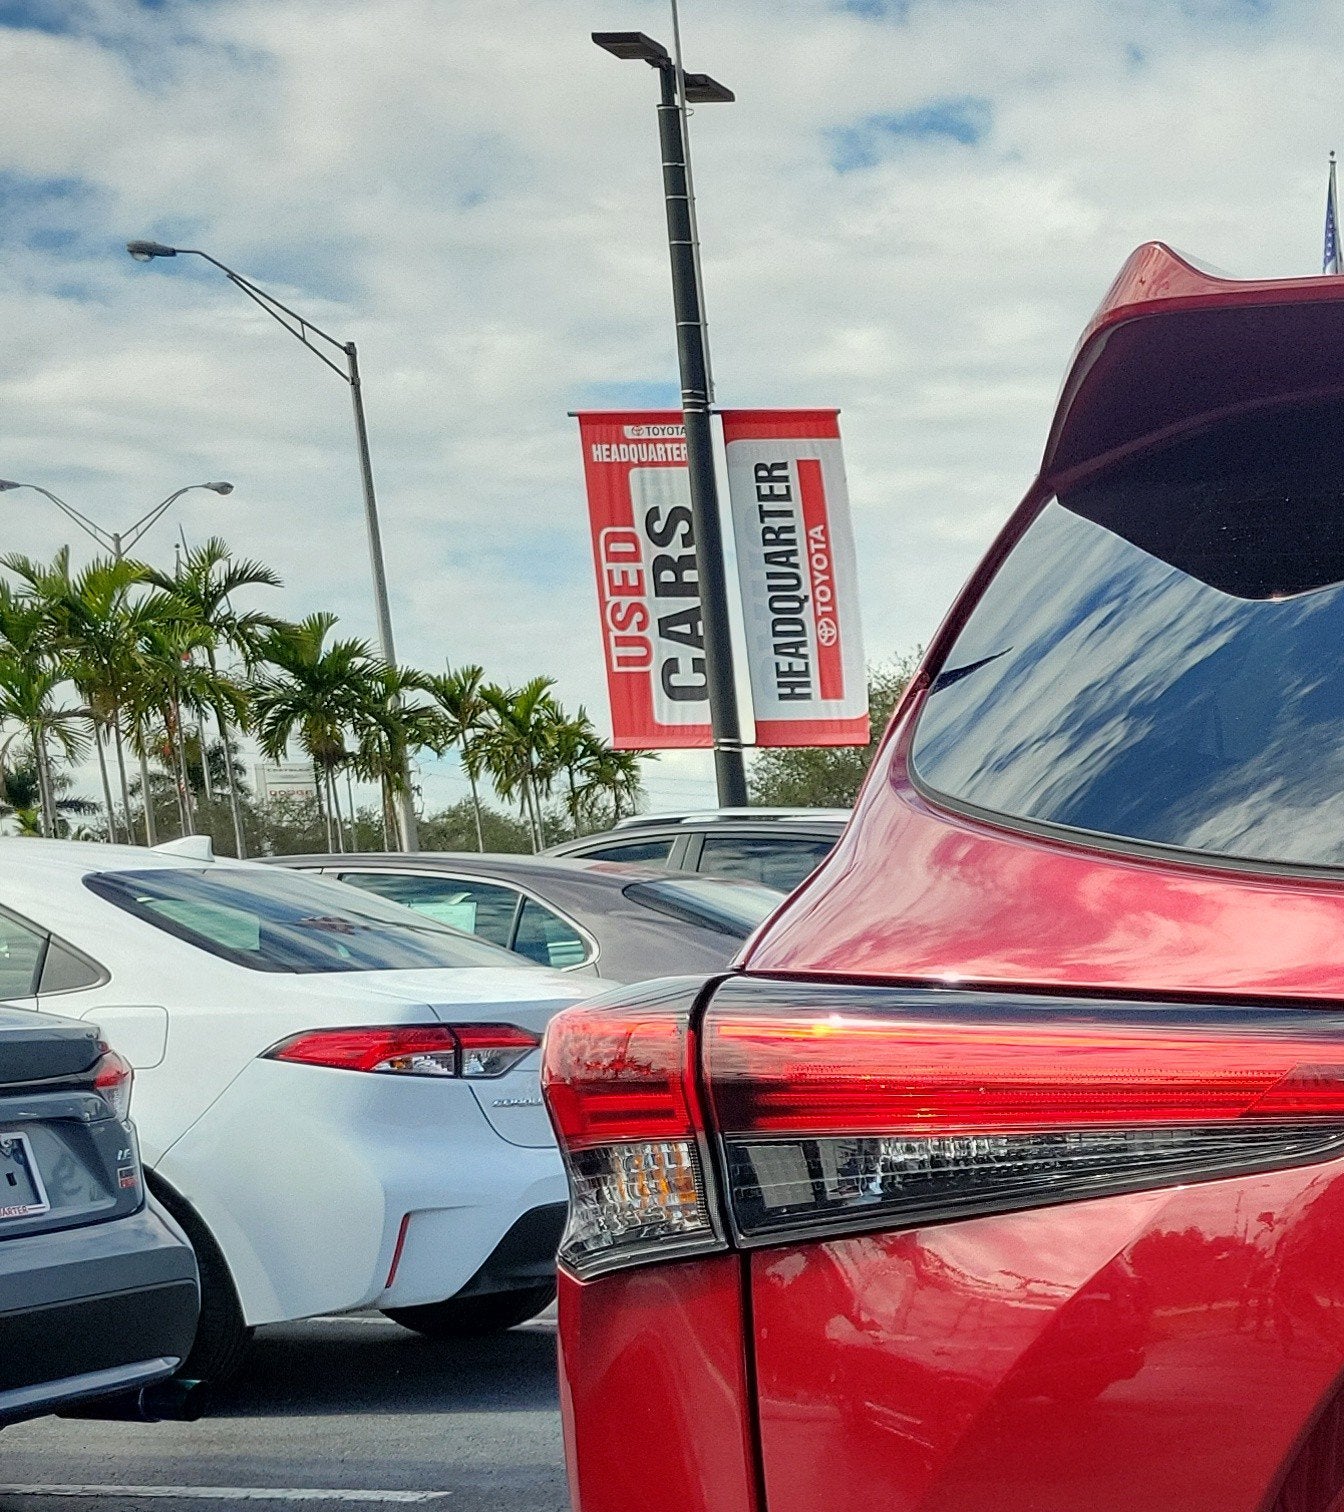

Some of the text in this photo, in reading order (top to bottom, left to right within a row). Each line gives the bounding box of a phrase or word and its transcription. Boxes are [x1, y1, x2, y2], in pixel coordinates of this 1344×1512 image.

[592, 443, 688, 463] HEADQUARTER
[600, 527, 653, 673] USED
[645, 505, 709, 701] CARS
[754, 460, 812, 701] HEADQUARTER
[808, 524, 833, 617] TOYOTA
